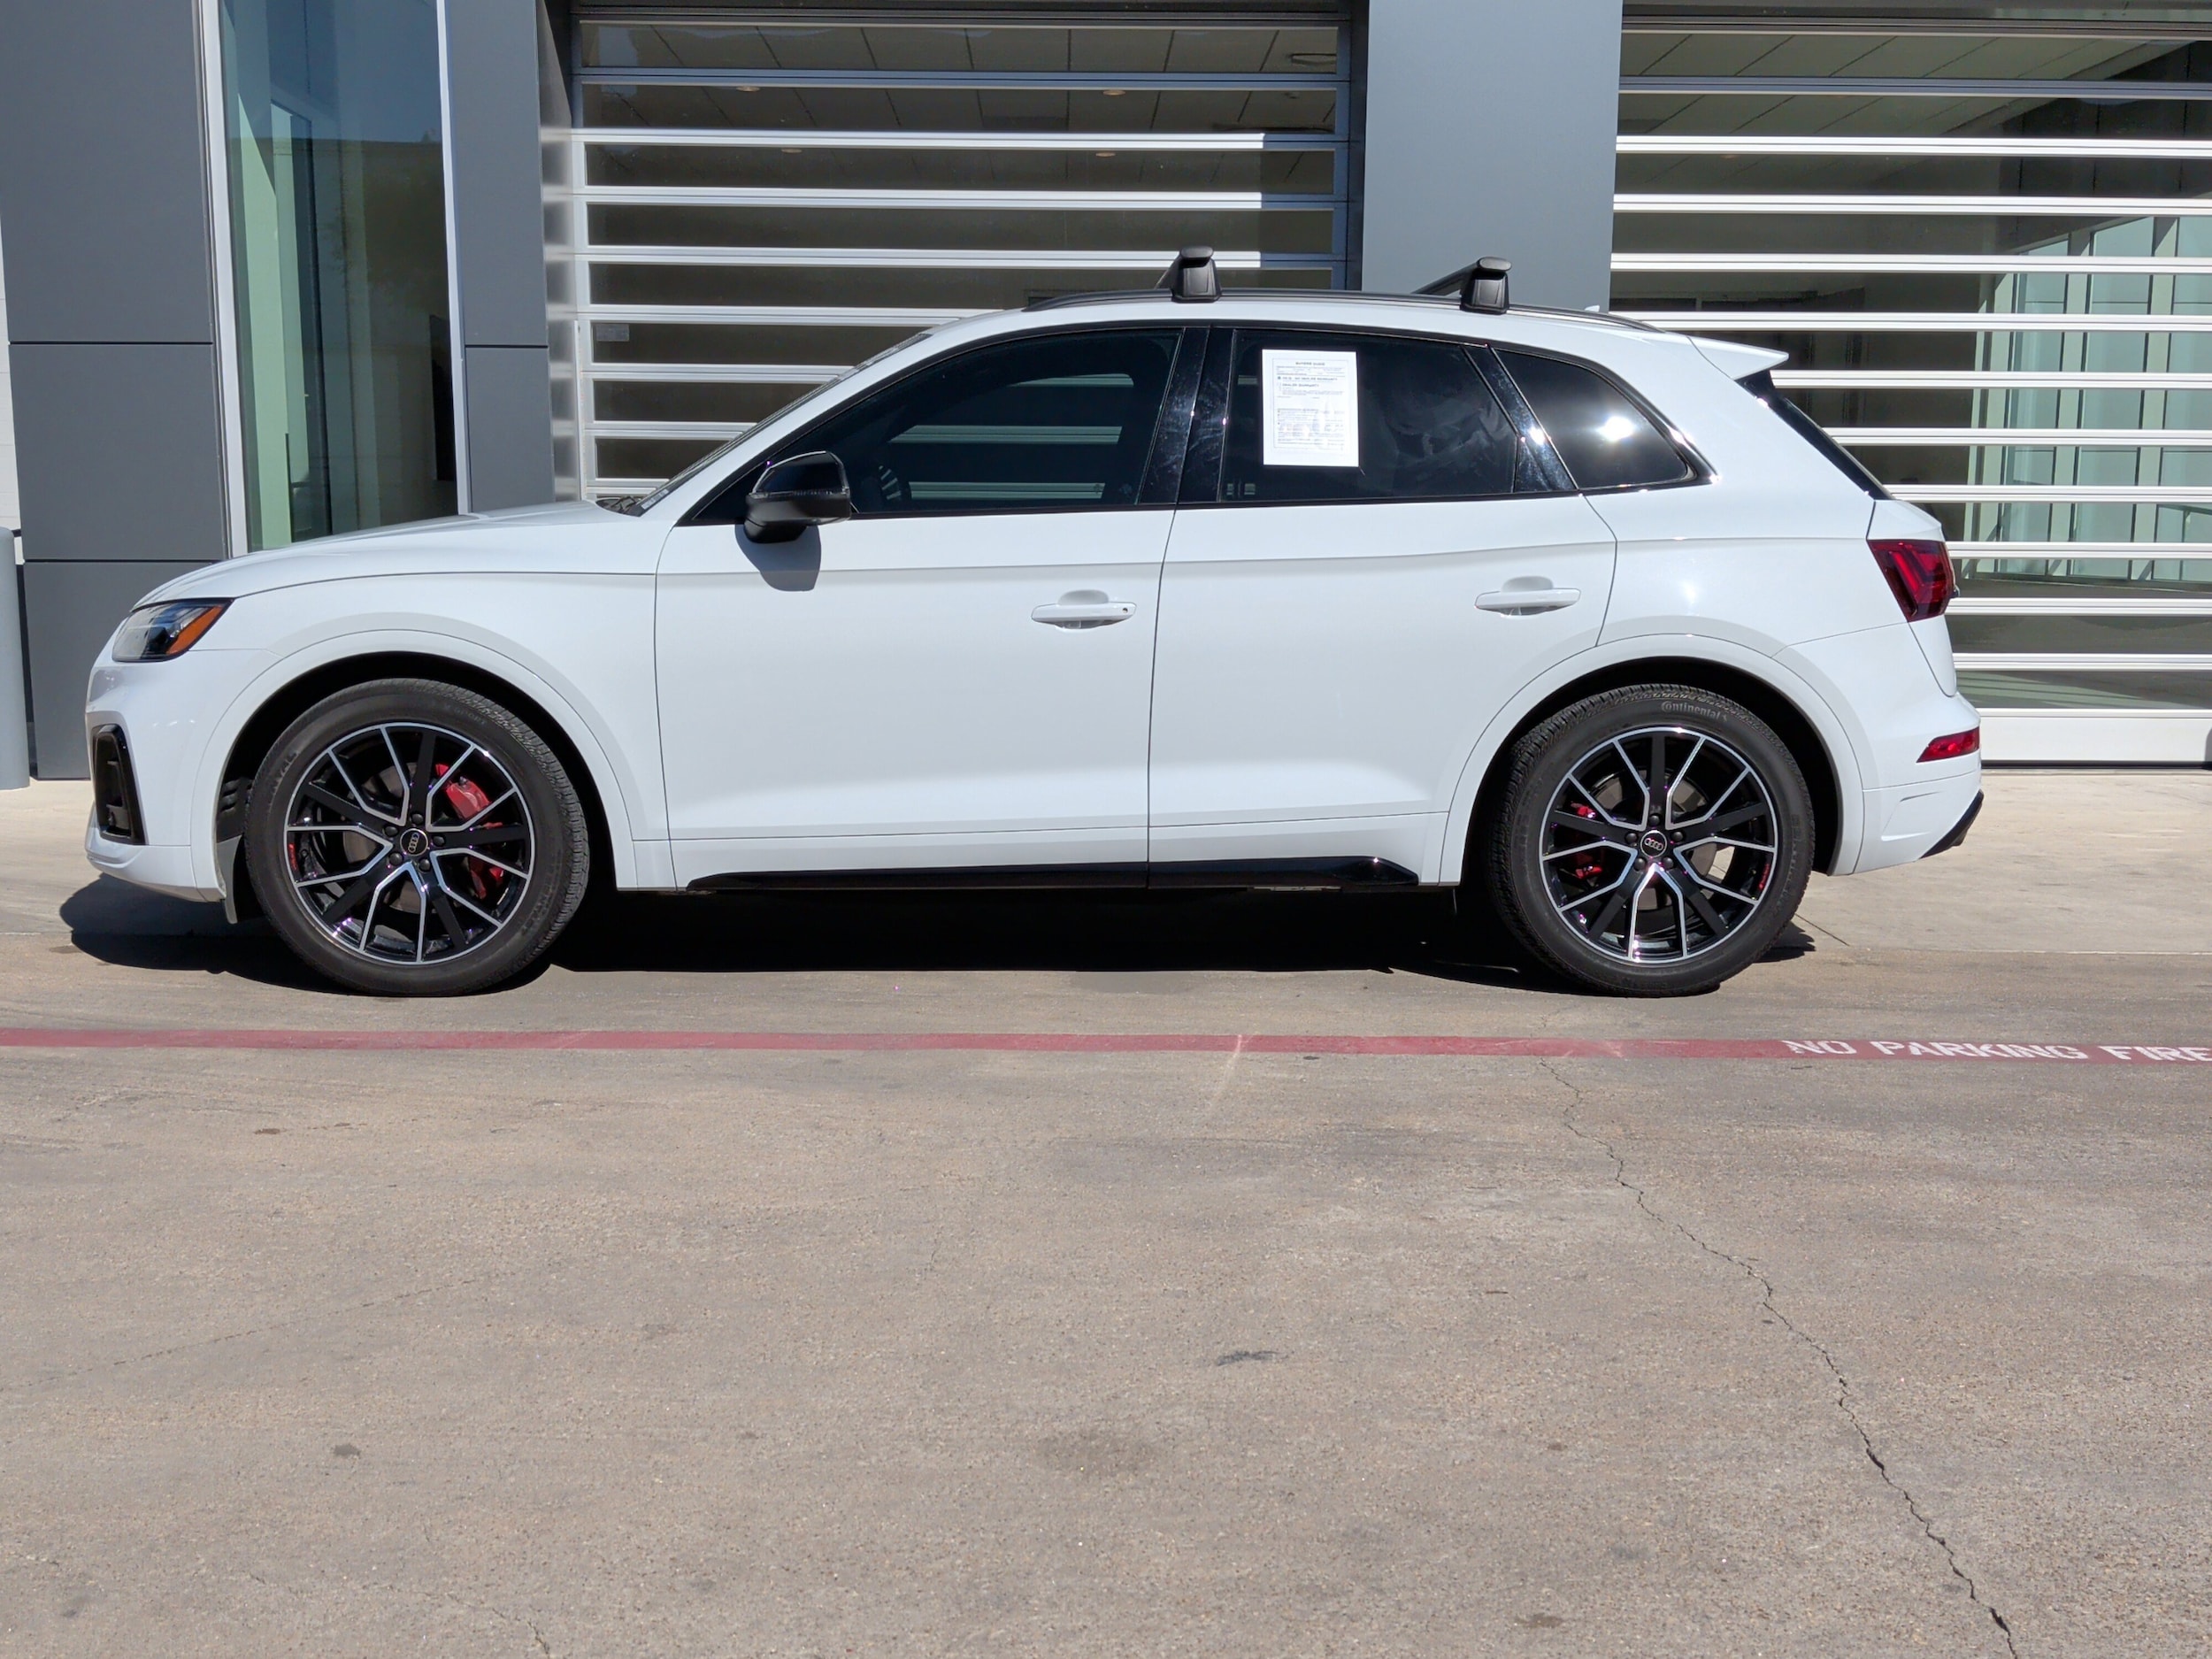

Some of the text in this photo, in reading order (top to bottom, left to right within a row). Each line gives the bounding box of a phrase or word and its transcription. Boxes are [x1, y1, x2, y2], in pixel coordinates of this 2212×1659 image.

[1661, 701, 1721, 720] Continental
[1781, 1040, 2212, 1061] NO PARKING FIRE
